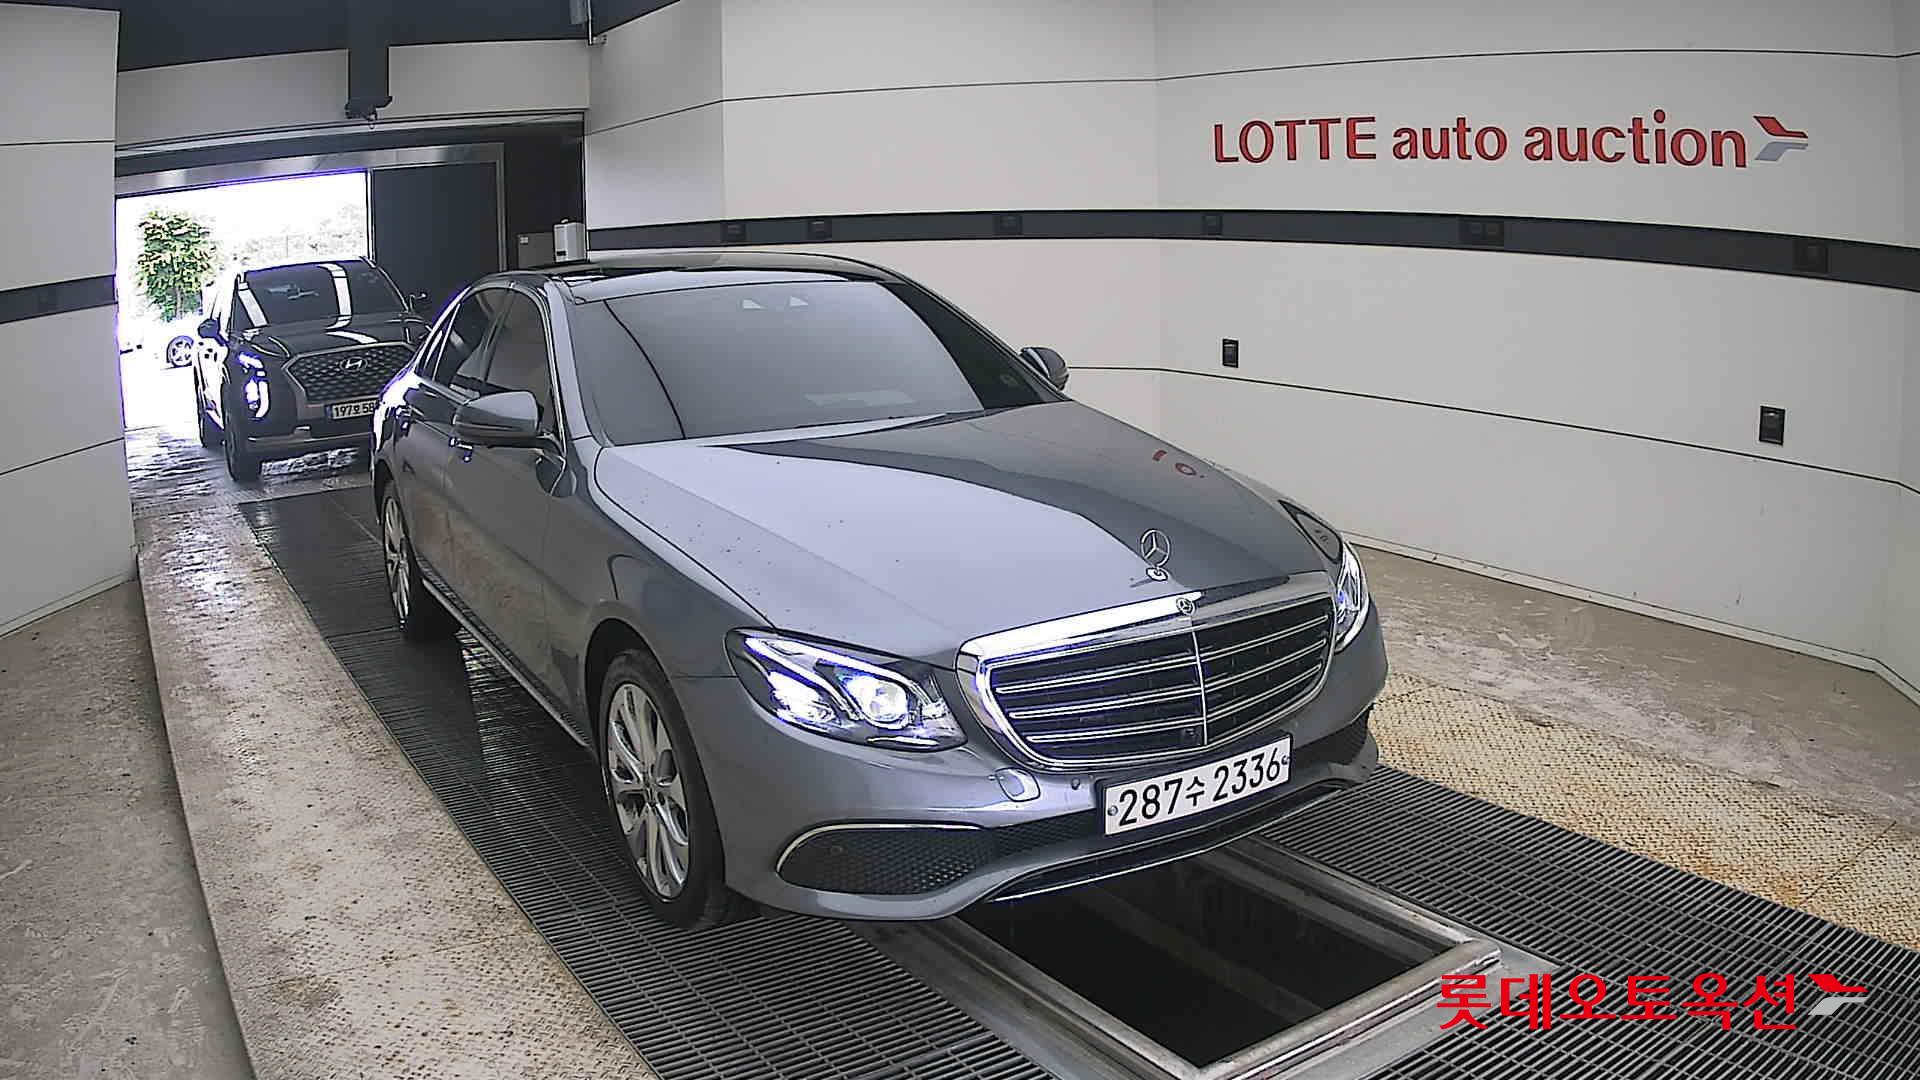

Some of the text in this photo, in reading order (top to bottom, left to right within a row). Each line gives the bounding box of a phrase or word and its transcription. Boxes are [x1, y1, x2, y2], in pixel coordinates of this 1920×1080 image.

[1213, 109, 1747, 168] LOTTE auto auction
[1119, 747, 1281, 826] 287수 2336
